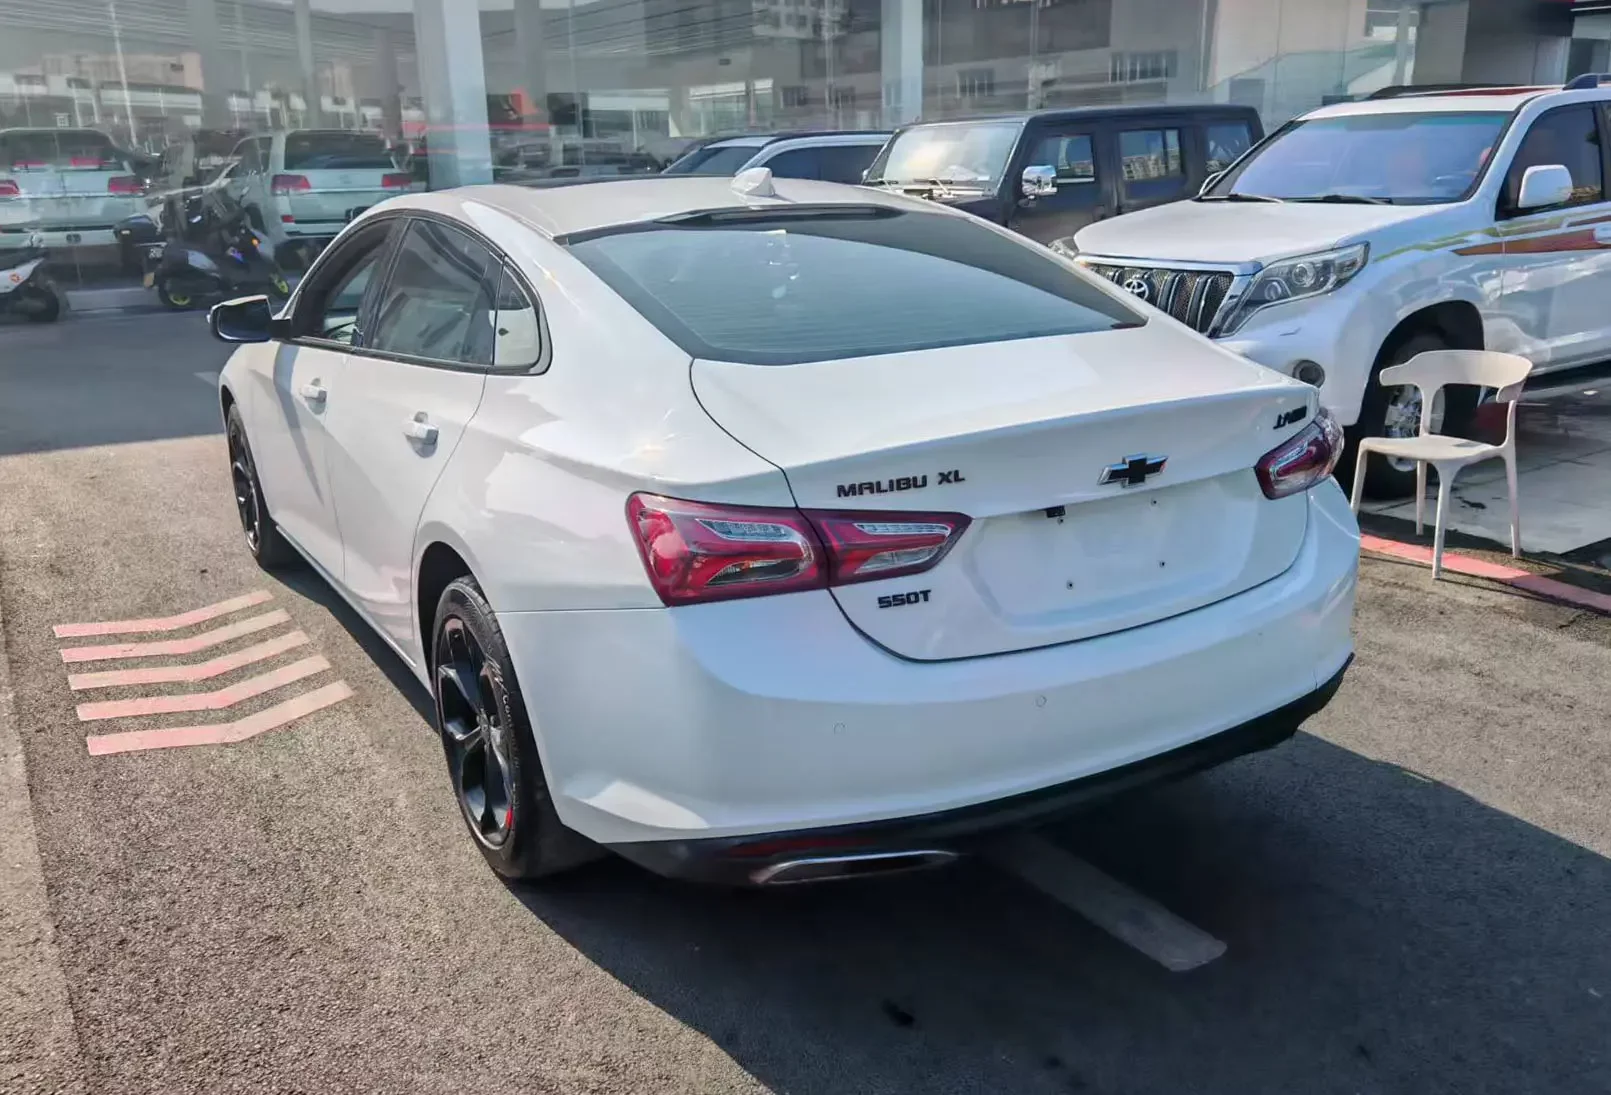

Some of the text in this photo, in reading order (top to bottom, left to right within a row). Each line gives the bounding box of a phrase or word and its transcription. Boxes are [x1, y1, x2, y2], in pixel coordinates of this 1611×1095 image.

[836, 469, 966, 498] MALIBU XL
[877, 589, 932, 609] 550T
